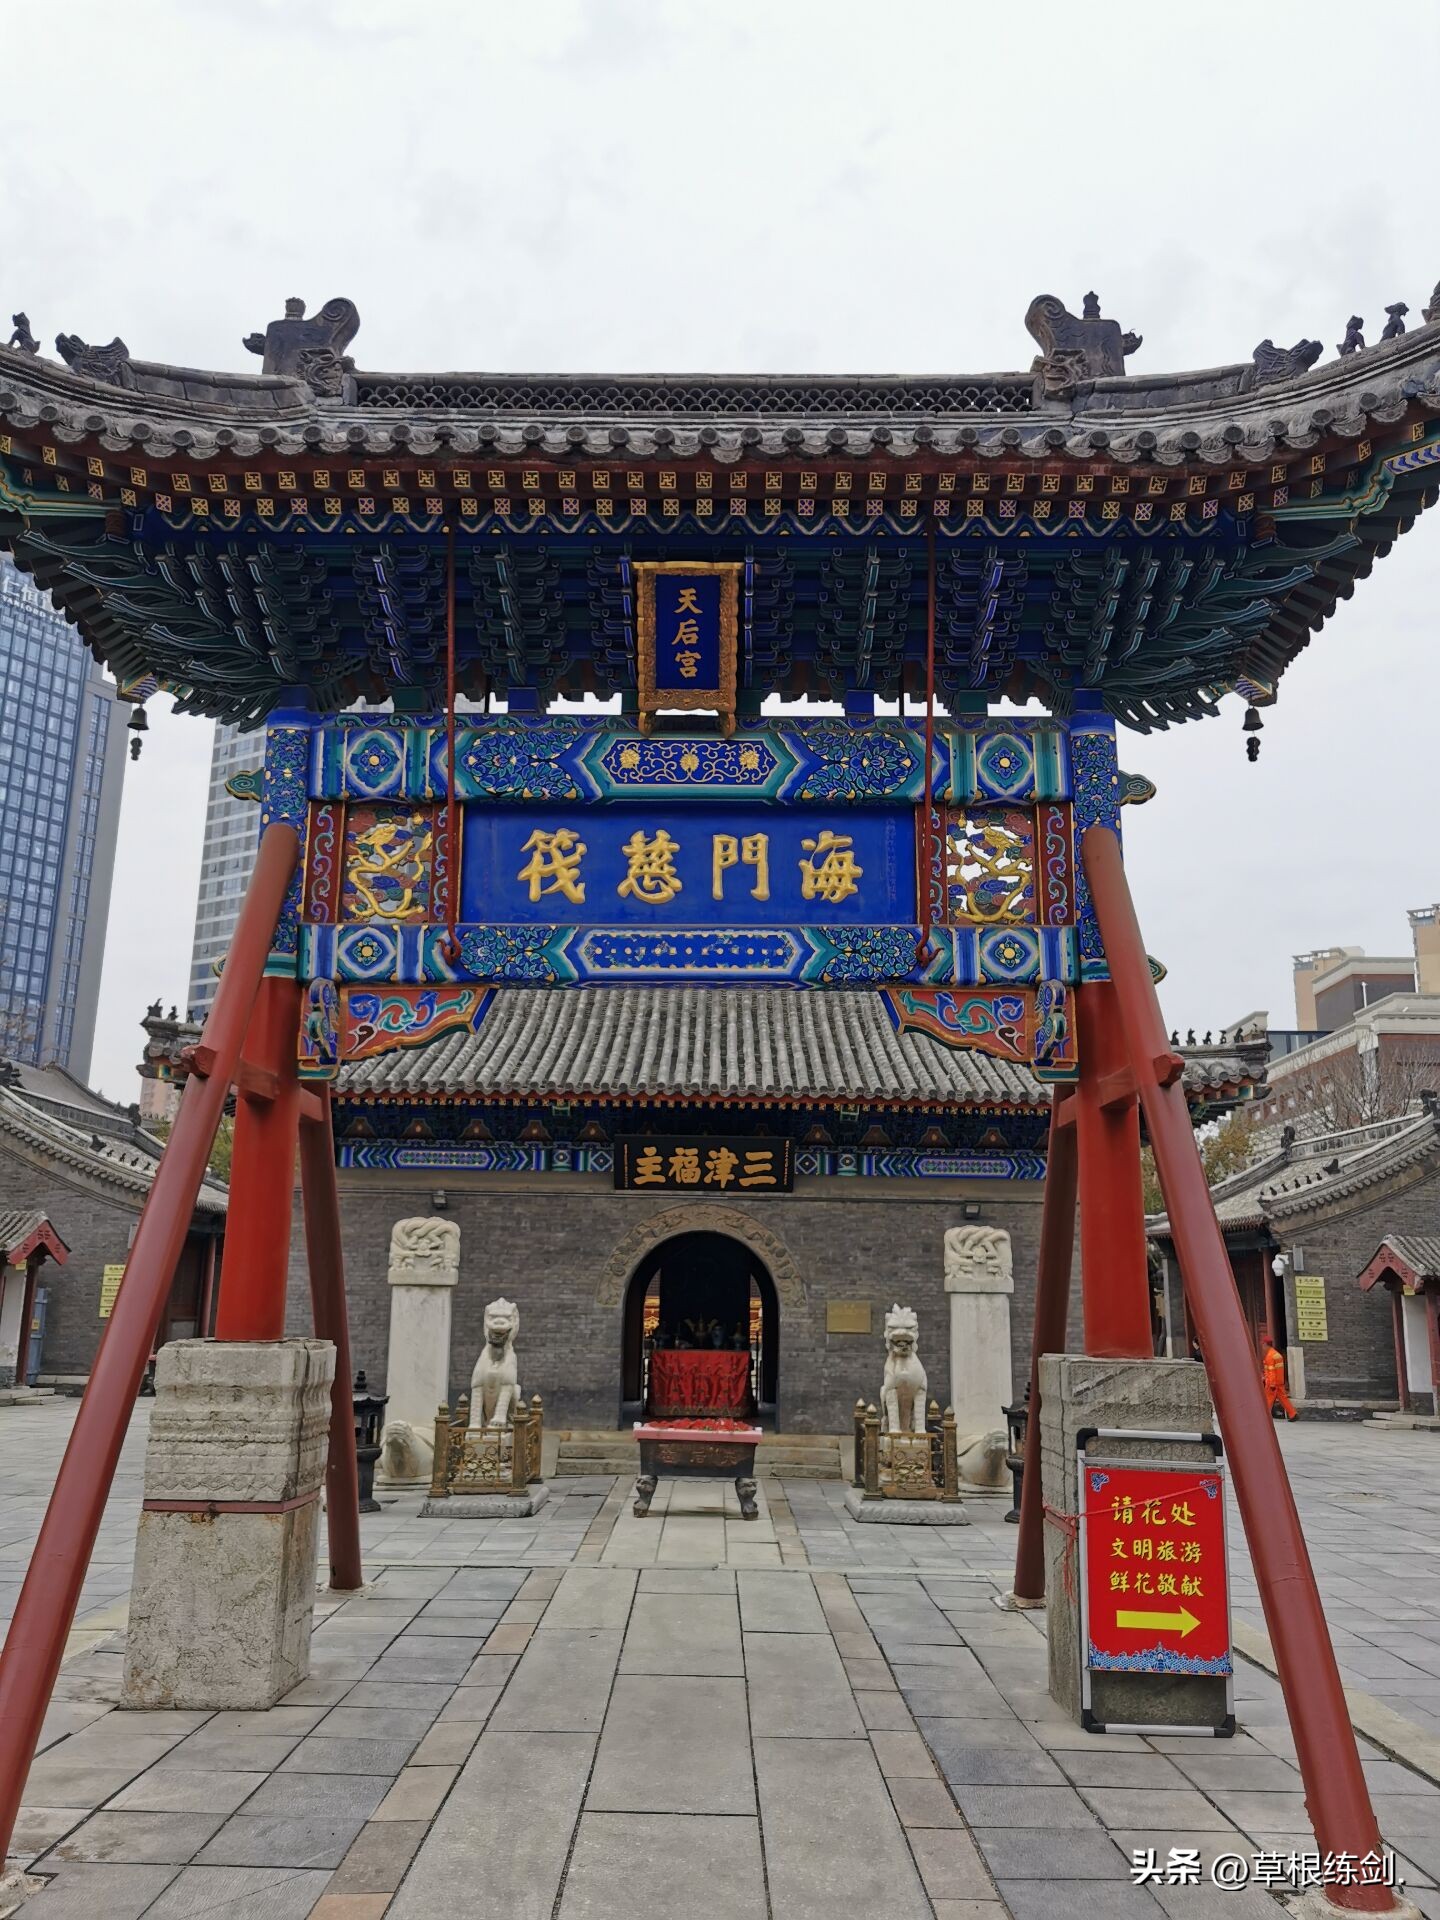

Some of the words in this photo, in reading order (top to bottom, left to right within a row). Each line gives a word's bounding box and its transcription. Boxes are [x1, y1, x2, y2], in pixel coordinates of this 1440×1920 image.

[671, 587, 703, 679] 天后宫
[1111, 1496, 1197, 1527] 请花处
[1110, 1538, 1203, 1564] 文明旅游
[1109, 1571, 1205, 1597] 鲜花敬献
